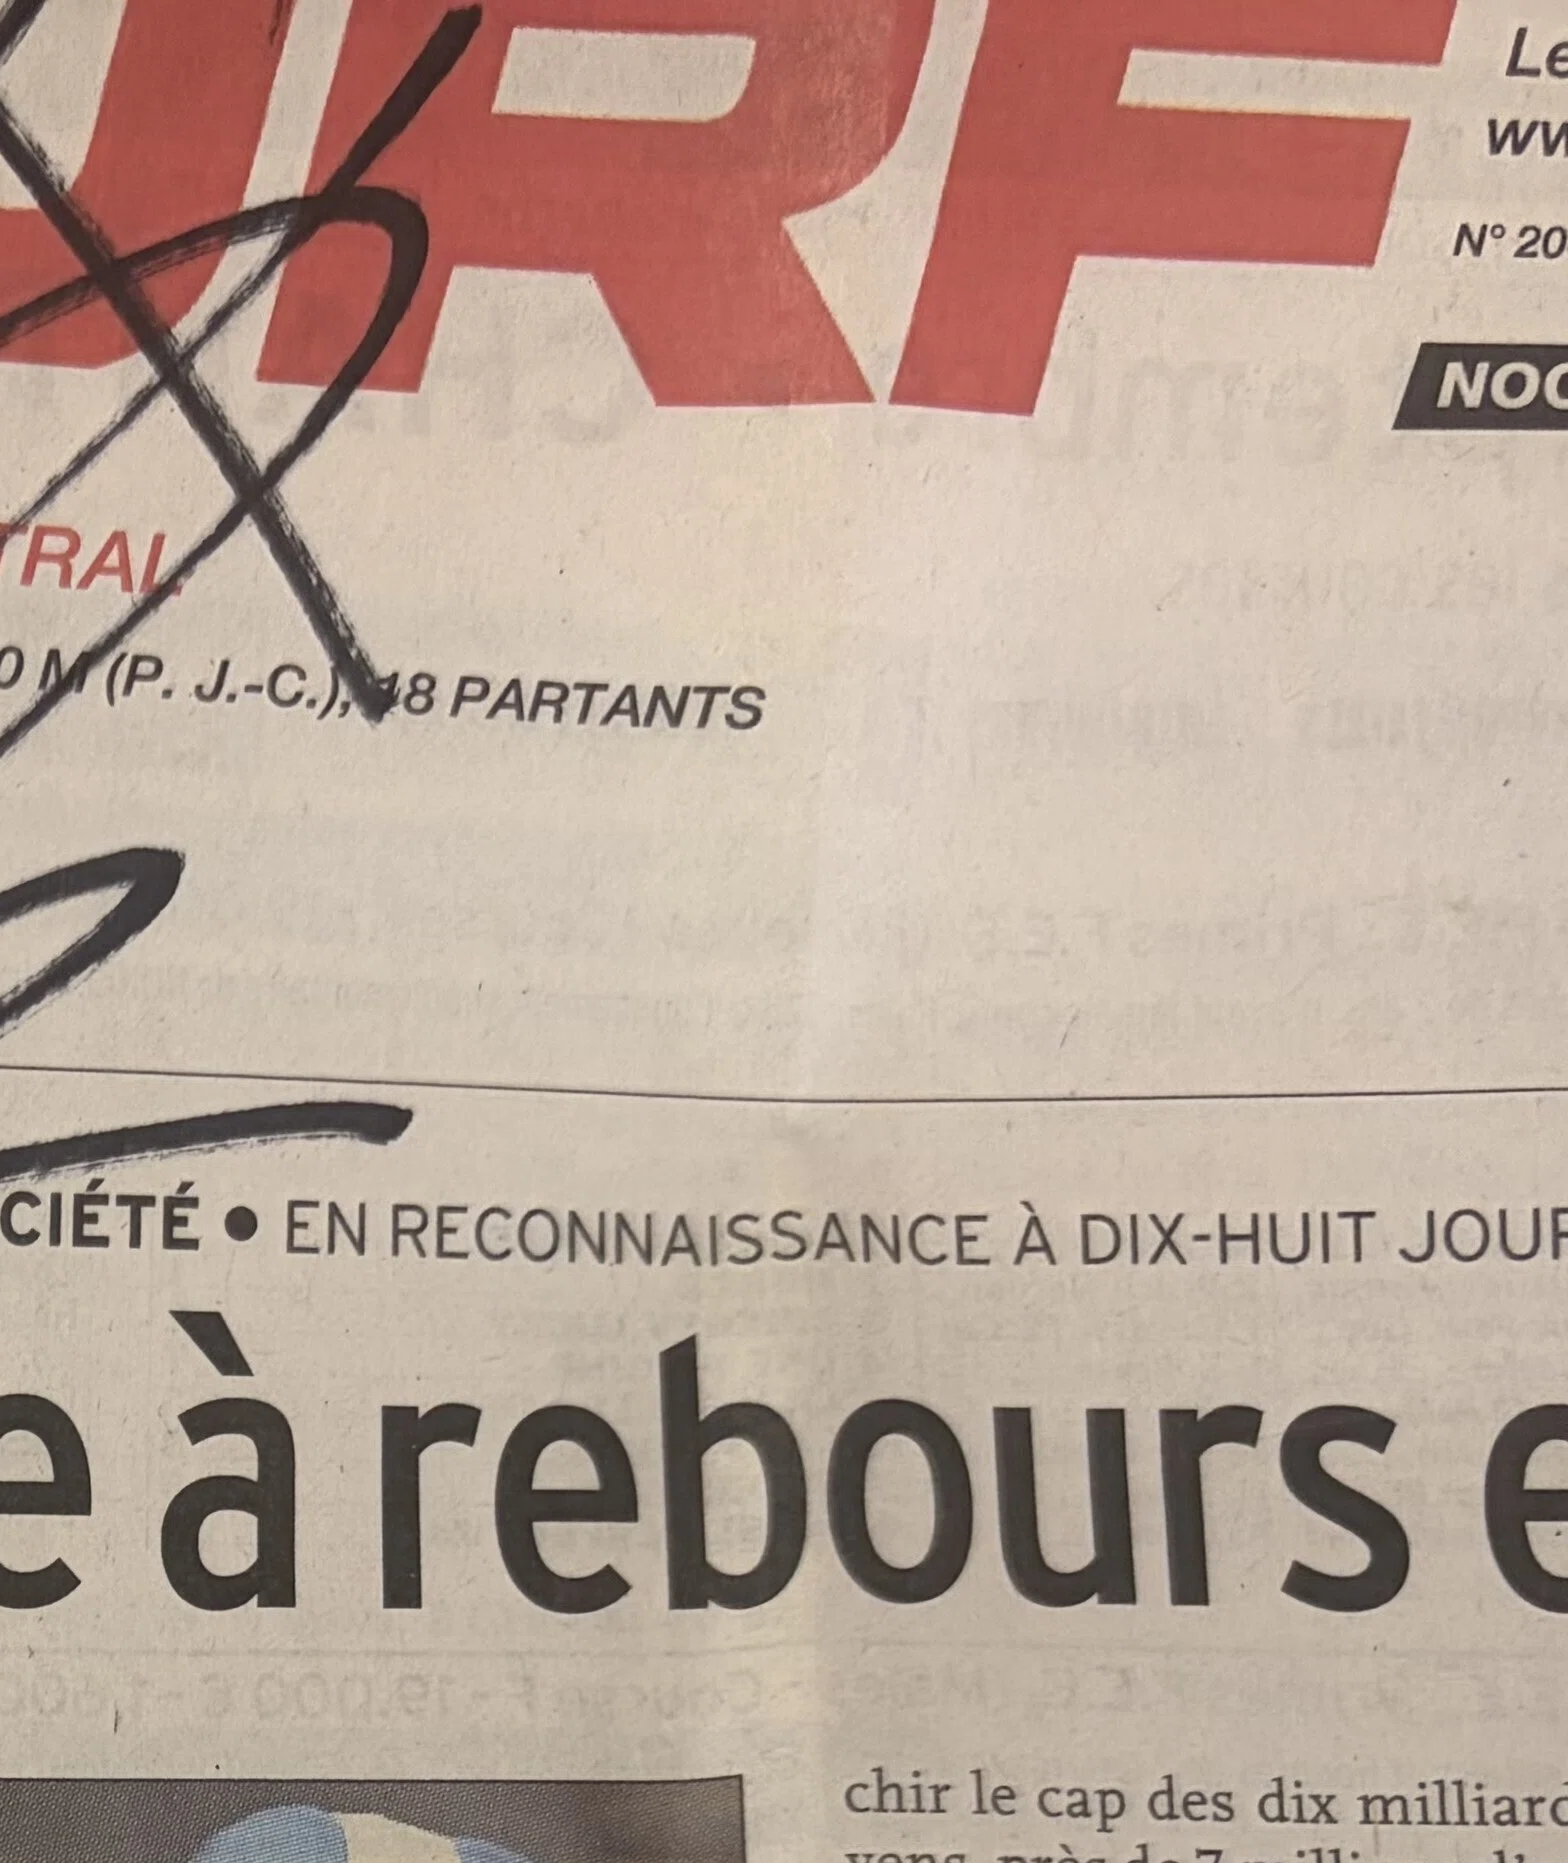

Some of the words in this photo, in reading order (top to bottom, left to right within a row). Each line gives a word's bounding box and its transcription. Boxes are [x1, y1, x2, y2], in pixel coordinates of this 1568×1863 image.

[1453, 222, 1505, 258] N°
[105, 652, 174, 706] (P.
[449, 675, 767, 731] PARTANTS
[286, 1199, 367, 1256] EN
[391, 1203, 992, 1267] RECONNAISSANCE
[1013, 1200, 1057, 1266] À
[1080, 1210, 1377, 1266] DIX-HUIT
[160, 1309, 297, 1612] à
[380, 1333, 1412, 1615] rebours
